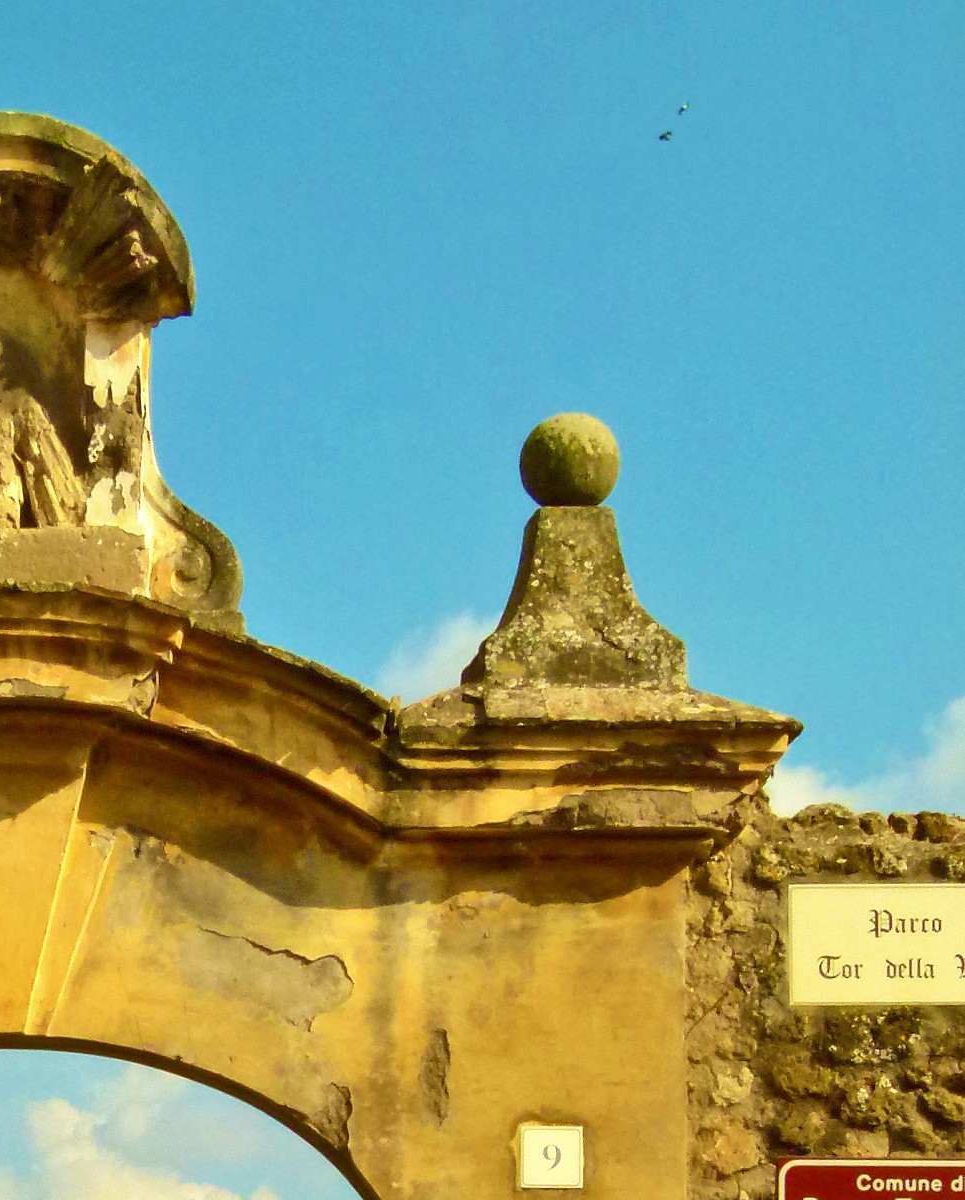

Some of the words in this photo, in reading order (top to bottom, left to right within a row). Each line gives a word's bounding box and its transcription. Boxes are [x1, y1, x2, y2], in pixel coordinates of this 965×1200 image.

[868, 909, 942, 938] Parco
[817, 955, 864, 980] Tor
[885, 958, 935, 979] della
[542, 1144, 562, 1171] 9
[856, 1174, 942, 1192] Comune
